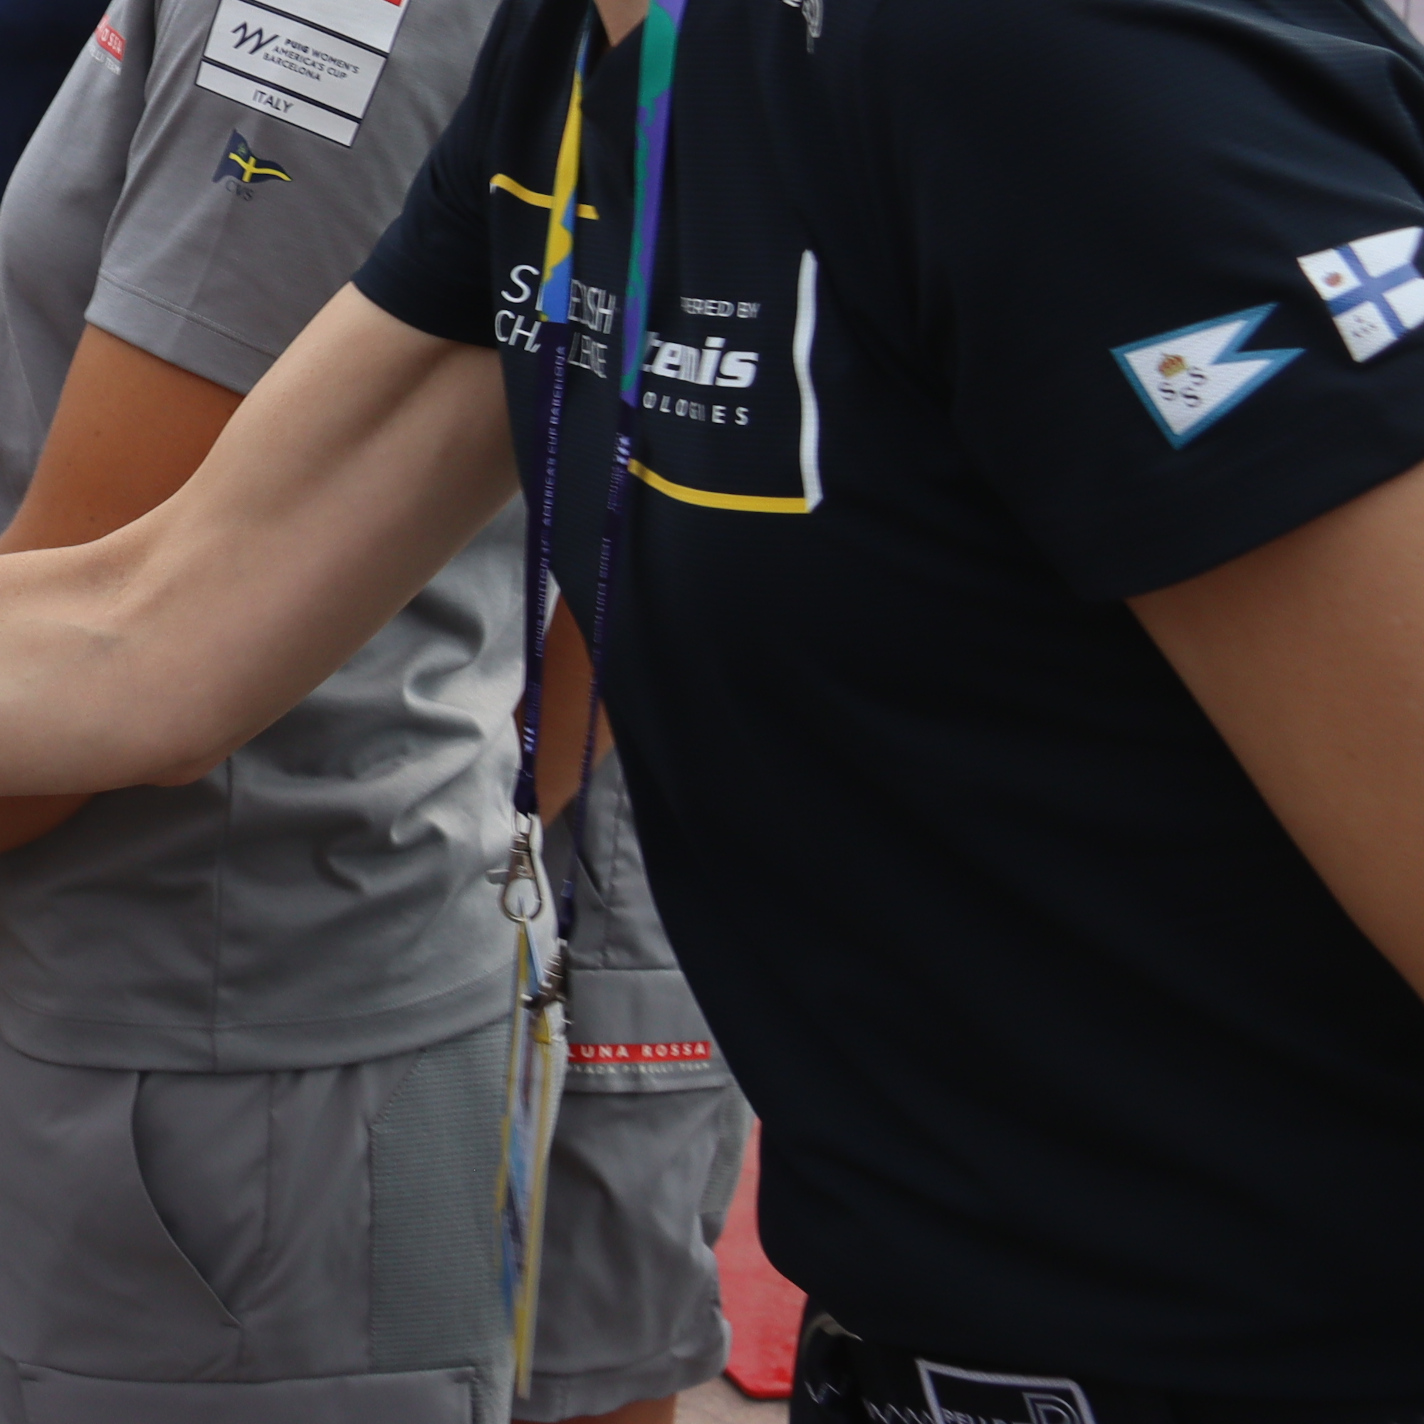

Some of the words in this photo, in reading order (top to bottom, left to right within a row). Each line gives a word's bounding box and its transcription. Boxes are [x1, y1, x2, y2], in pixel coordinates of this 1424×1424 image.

[262, 51, 322, 82] BARCELONA
[271, 45, 326, 72] AMERICA'S
[326, 65, 348, 80] CUP
[284, 38, 311, 54] PUIG
[312, 48, 360, 75] WOMEN'S
[252, 89, 294, 114] ITALY
[641, 1042, 706, 1058] ROSSA
